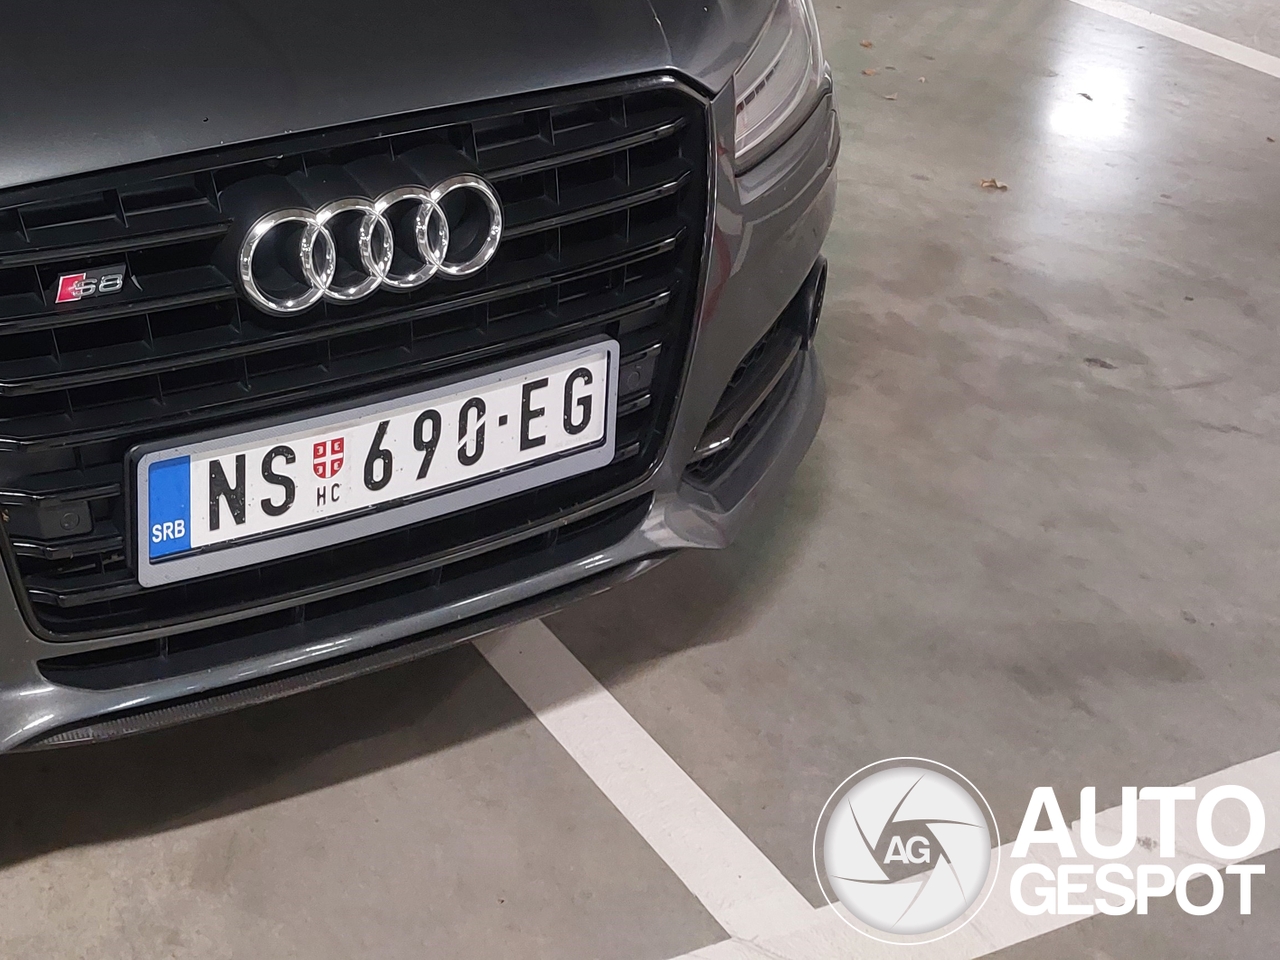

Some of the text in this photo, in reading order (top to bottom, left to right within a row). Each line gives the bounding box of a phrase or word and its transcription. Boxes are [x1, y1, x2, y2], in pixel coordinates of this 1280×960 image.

[68, 273, 124, 298] S8
[209, 445, 296, 532] NS
[152, 519, 186, 543] SRB
